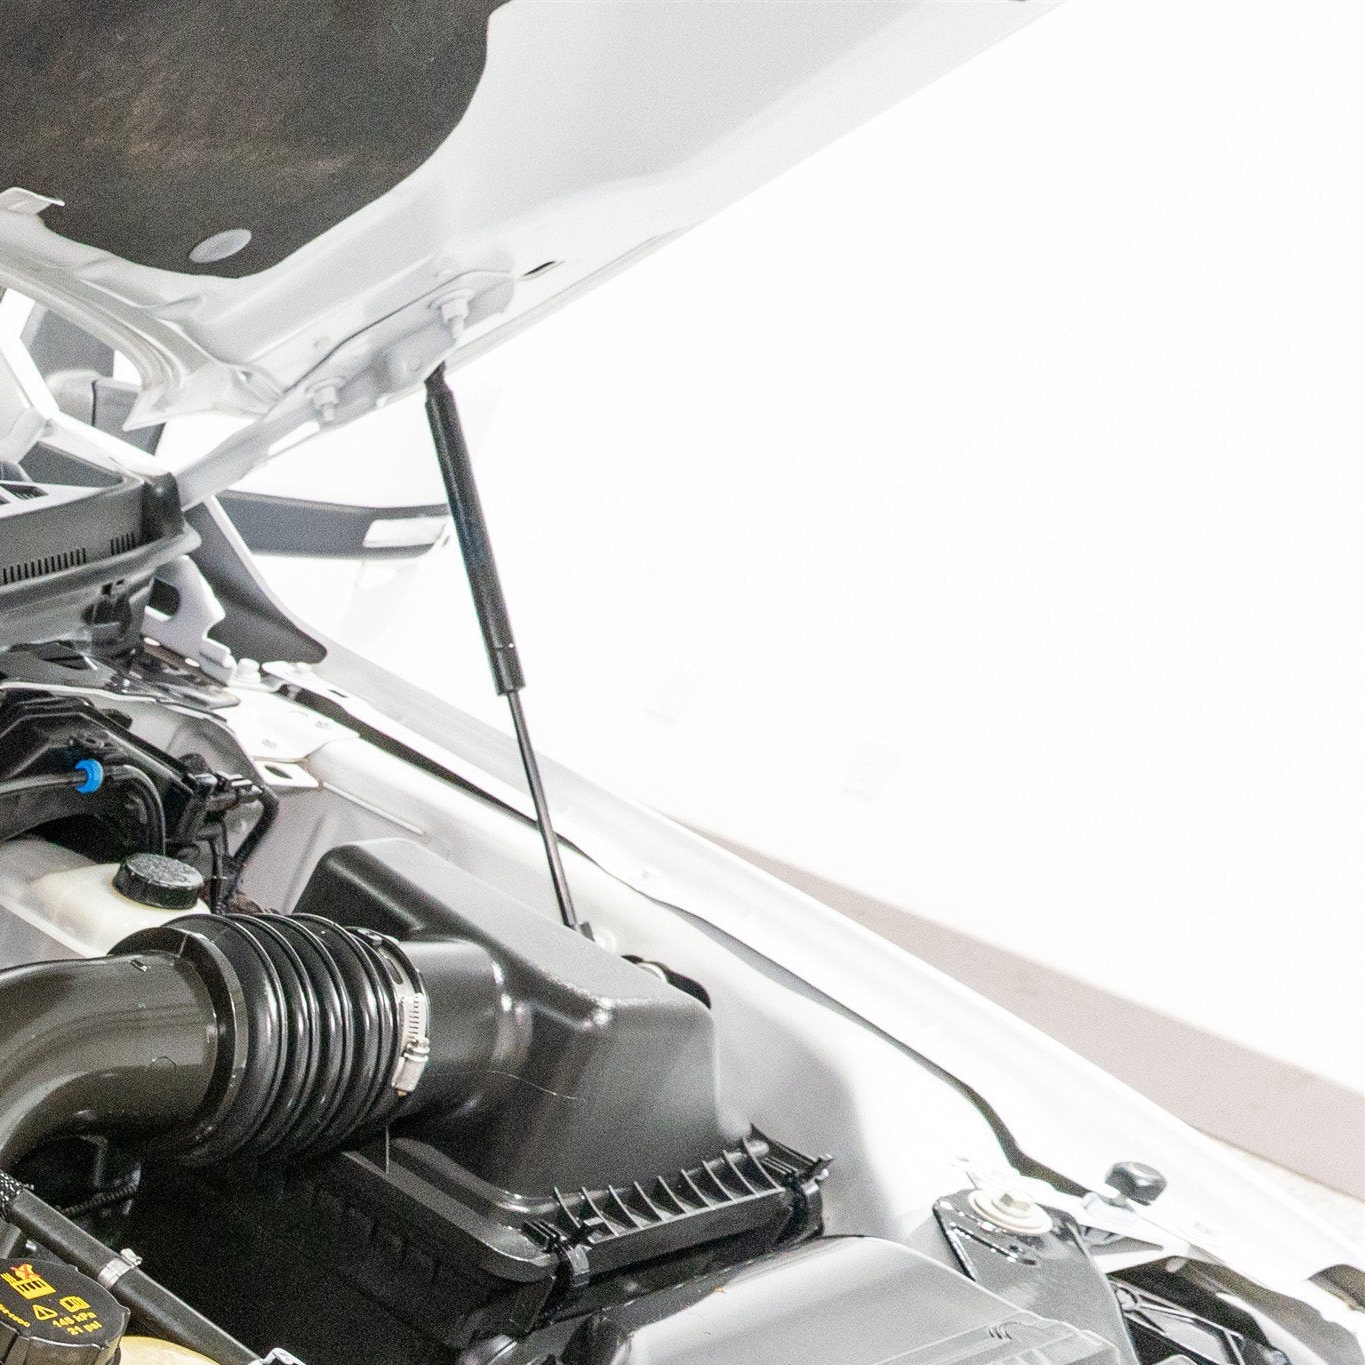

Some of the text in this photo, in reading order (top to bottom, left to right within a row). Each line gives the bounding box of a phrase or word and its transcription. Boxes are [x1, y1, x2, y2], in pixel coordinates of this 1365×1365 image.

[52, 1311, 97, 1328] 145 kPa
[67, 1320, 103, 1335] 21 psi
